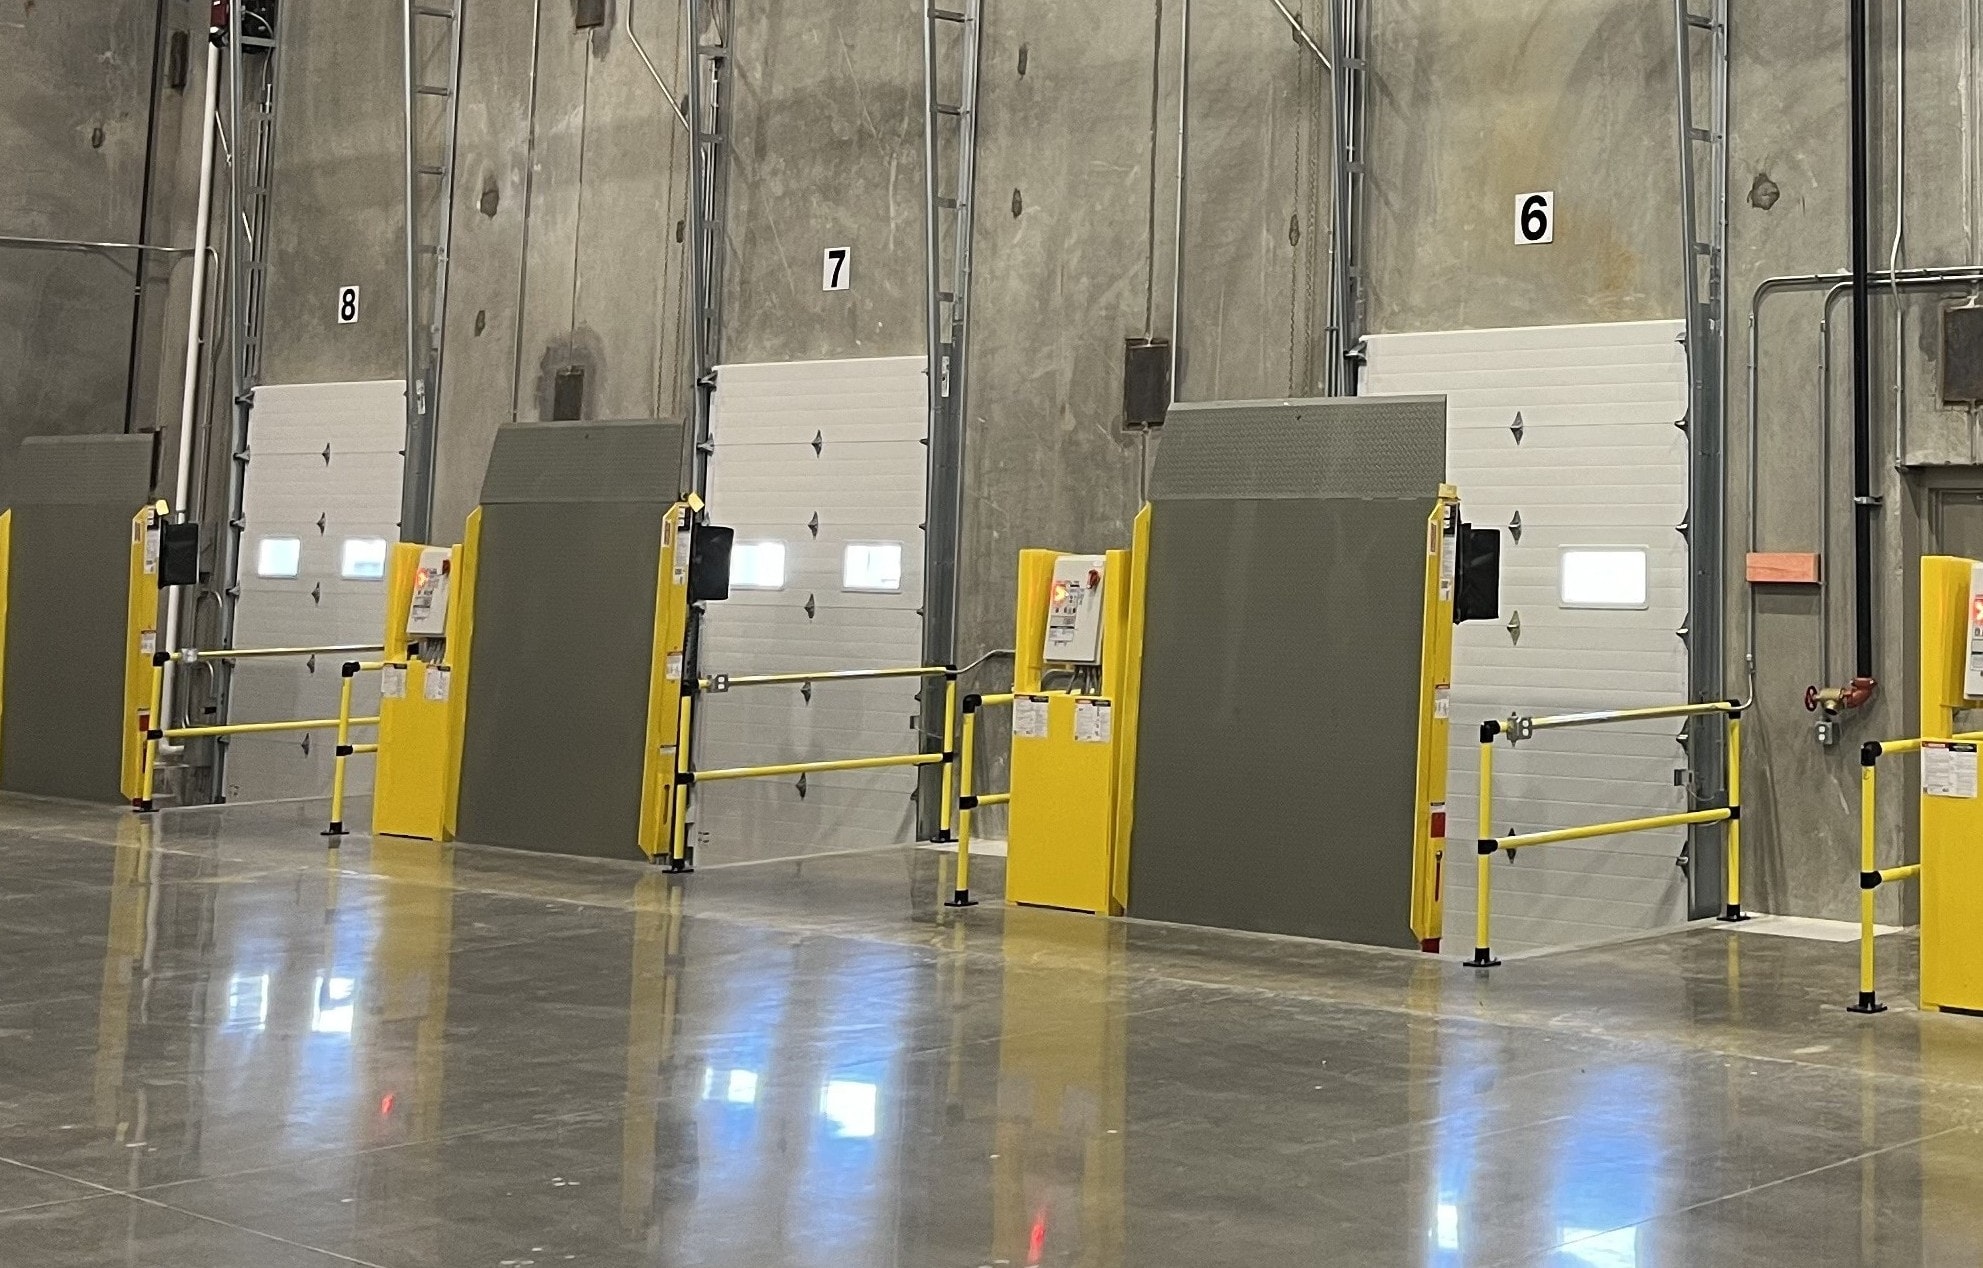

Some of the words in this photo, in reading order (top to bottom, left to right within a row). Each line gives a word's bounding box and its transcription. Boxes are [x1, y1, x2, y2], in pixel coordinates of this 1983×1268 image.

[1521, 195, 1547, 240] 6
[829, 250, 845, 287] 7
[341, 289, 355, 320] 8
